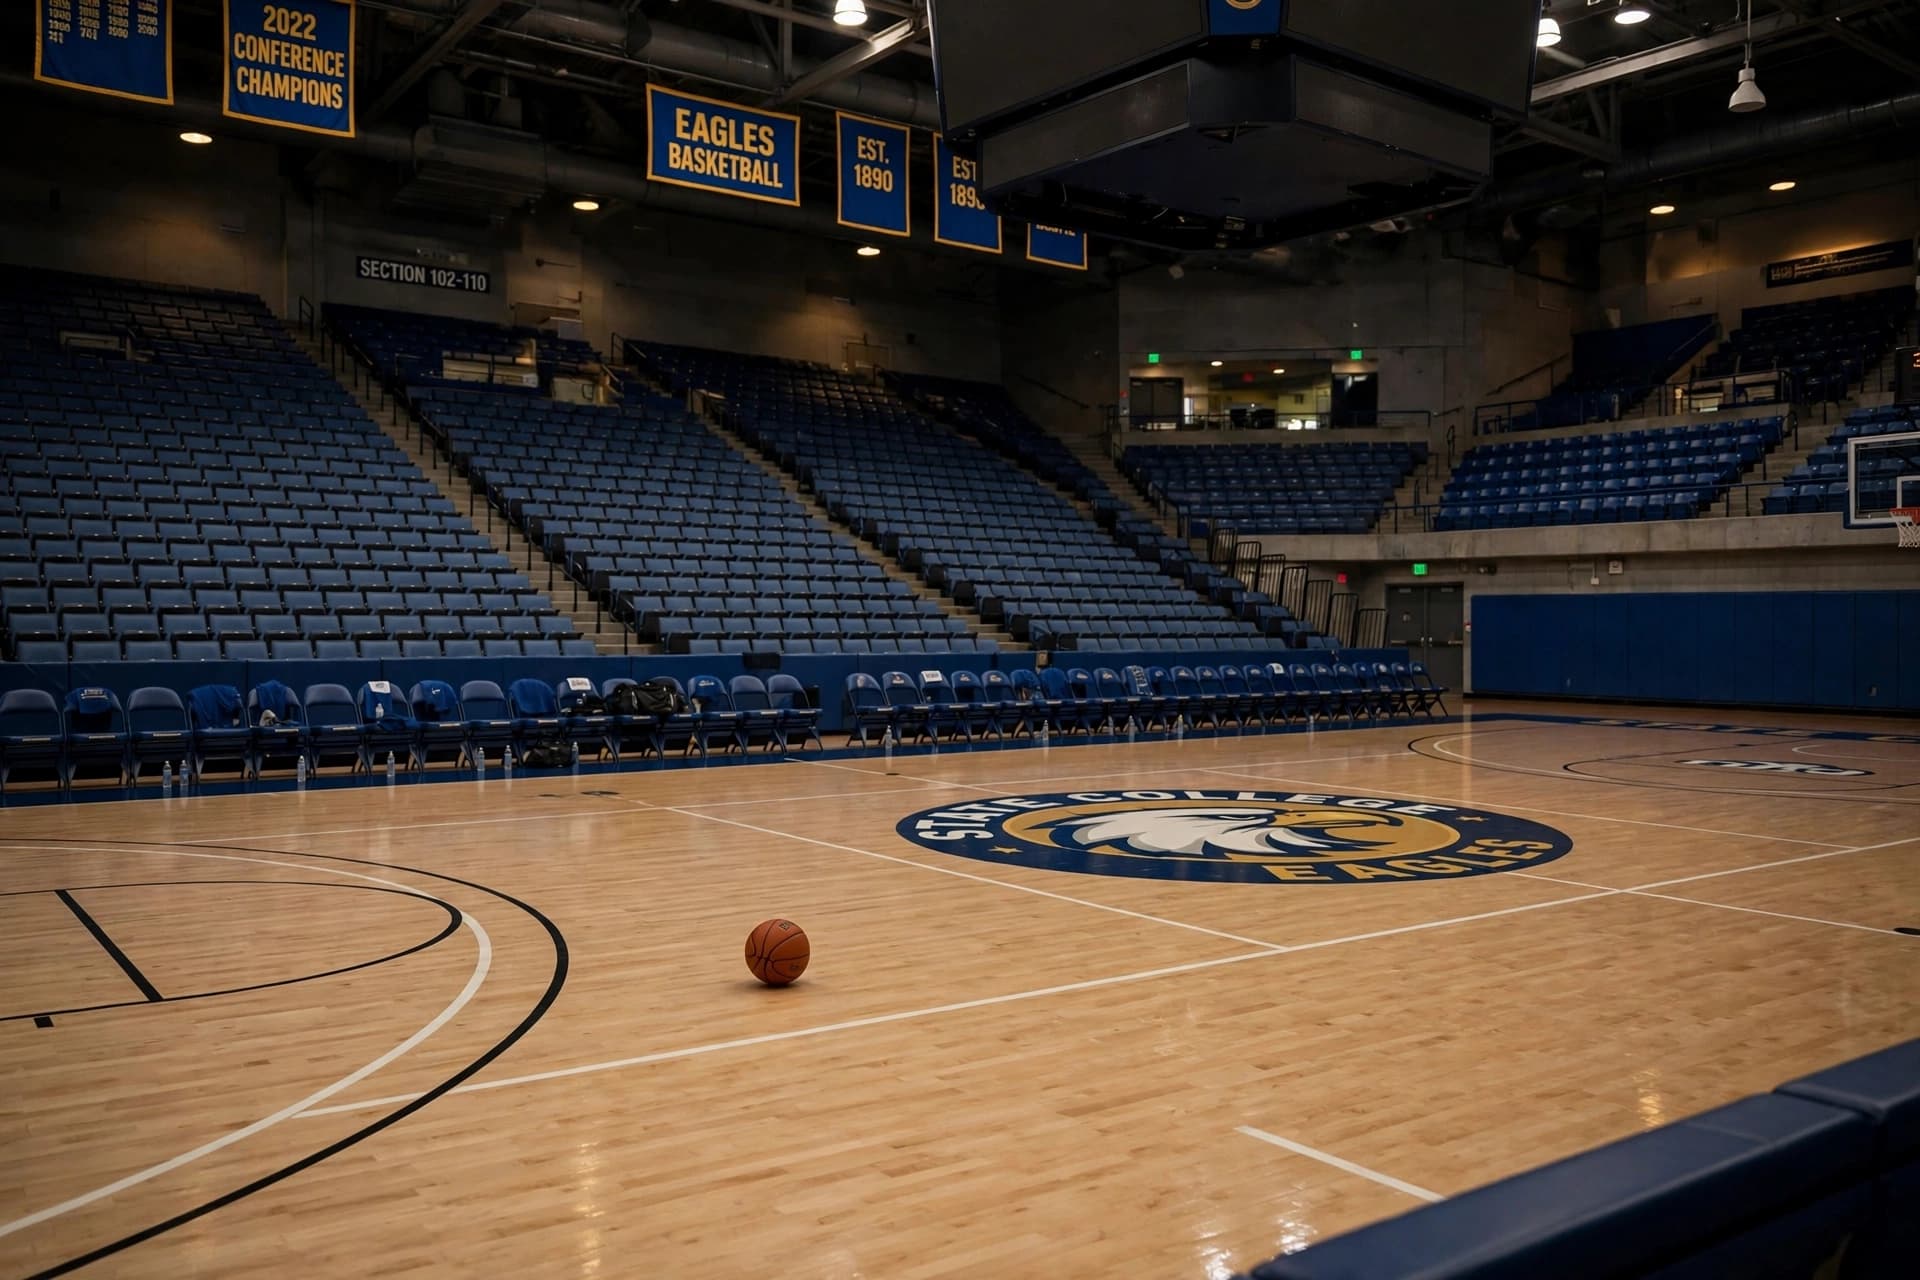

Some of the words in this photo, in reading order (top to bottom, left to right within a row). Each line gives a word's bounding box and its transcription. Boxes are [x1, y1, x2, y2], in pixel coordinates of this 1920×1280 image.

[263, 4, 317, 41] 2022
[234, 32, 345, 78] CONFERENCE
[236, 65, 343, 109] CHAMPIONS
[675, 107, 775, 157] EAGLES
[857, 136, 890, 165] EST.
[668, 141, 783, 188] BASKETBALL
[854, 164, 893, 193] 1890
[360, 259, 425, 284] SECTION
[430, 269, 487, 292] 102-110
[915, 798, 1064, 841] STATE
[1067, 790, 1459, 817] COLLEGE
[1262, 838, 1554, 881] EAGLES
